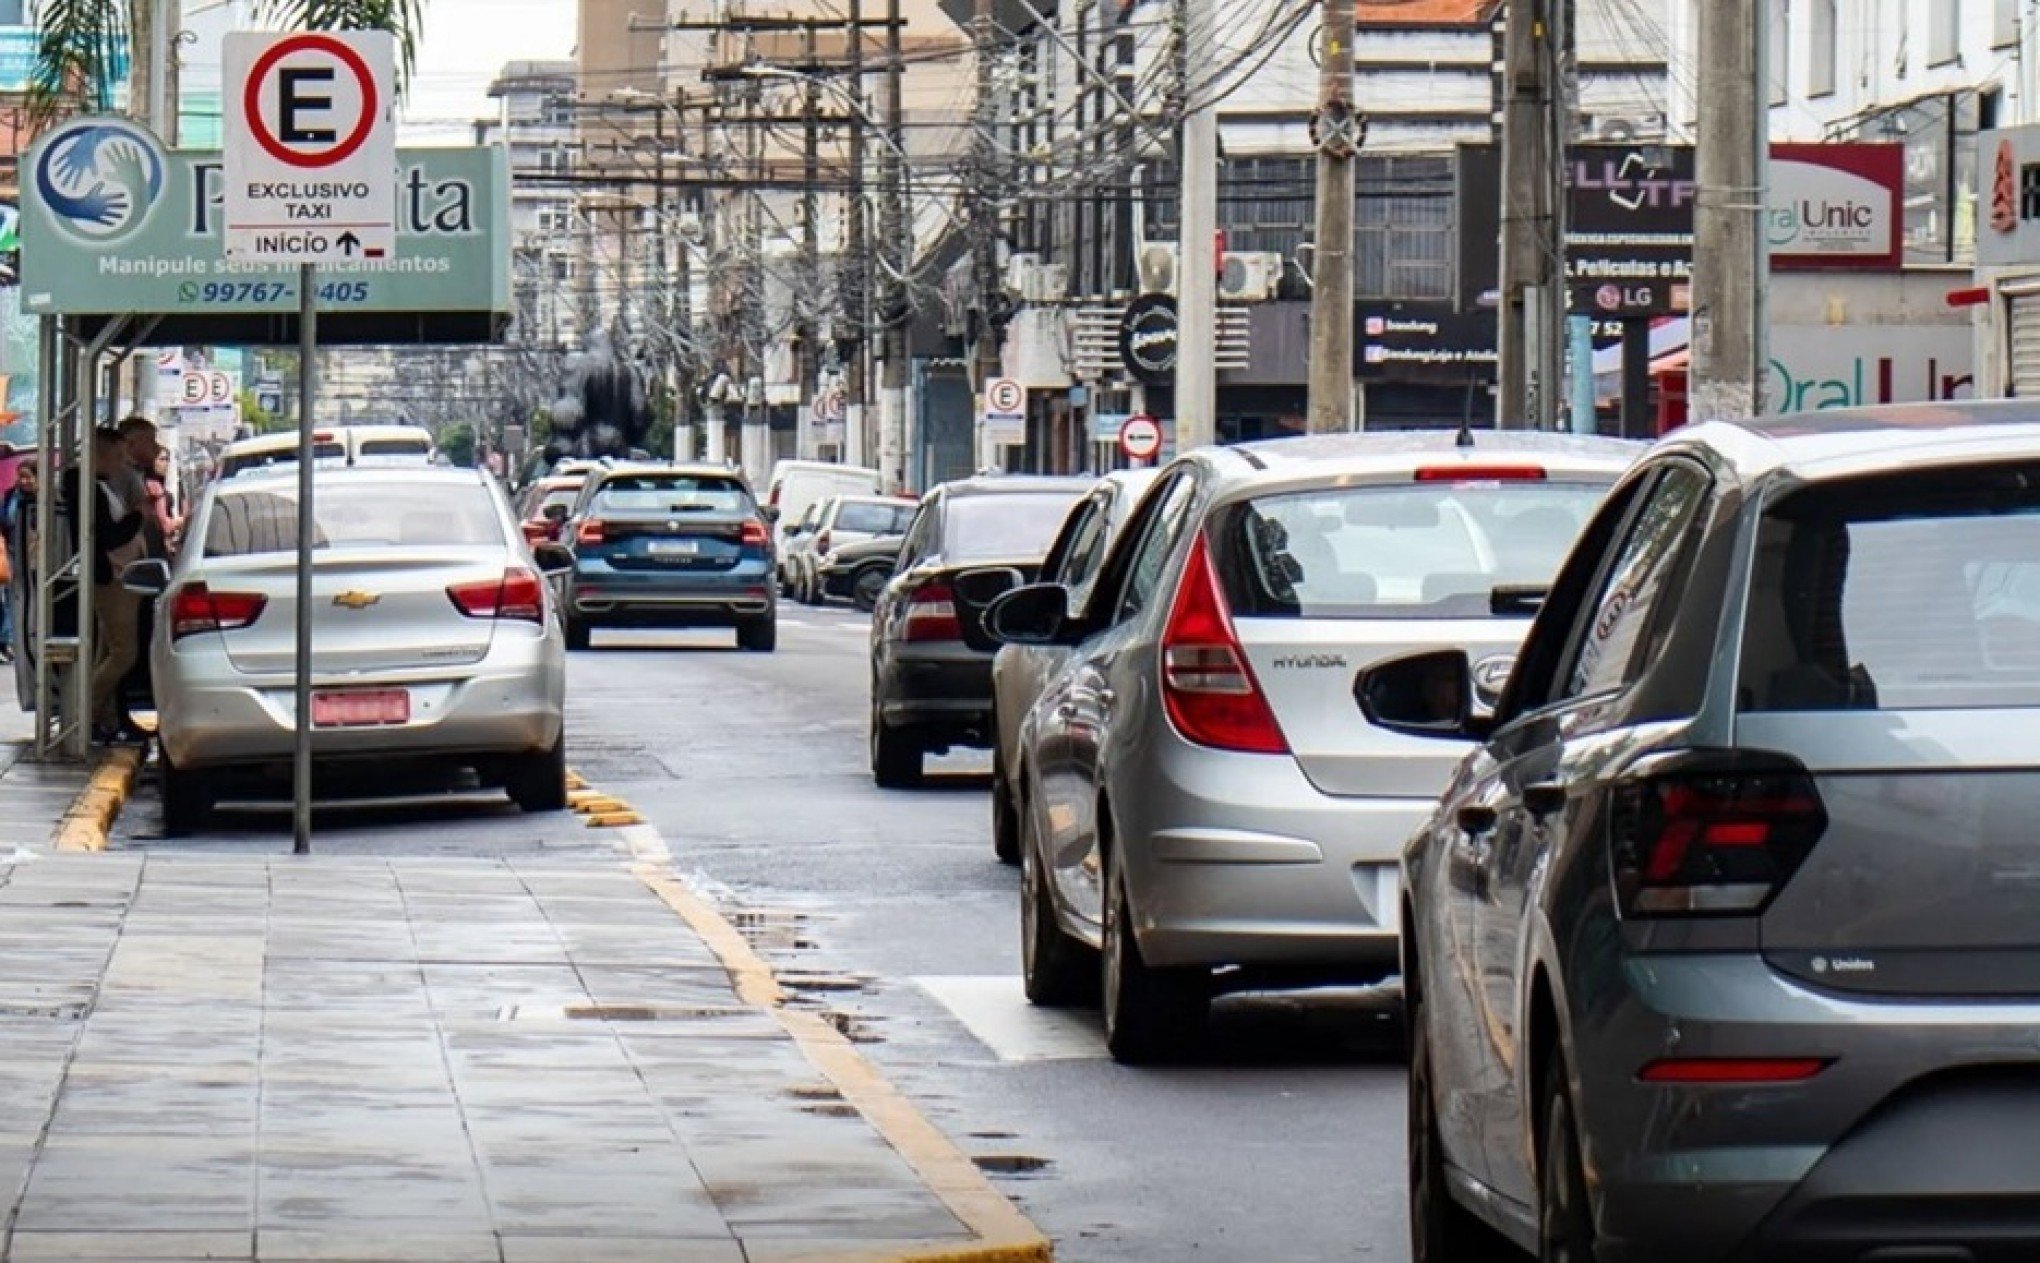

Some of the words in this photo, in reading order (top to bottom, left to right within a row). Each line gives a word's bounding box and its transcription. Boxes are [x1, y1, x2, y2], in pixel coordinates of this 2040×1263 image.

[279, 68, 337, 143] E
[247, 182, 370, 200] EXCLUSIVO
[285, 202, 333, 219] TAXI
[1802, 200, 1872, 228] Unic
[255, 231, 328, 254] INÍCIO
[100, 255, 206, 279] Manipule
[203, 282, 369, 302] 99767-405
[1624, 287, 1652, 306] LG
[1000, 386, 1012, 405] E
[1273, 654, 1347, 669] HYUNDAI
